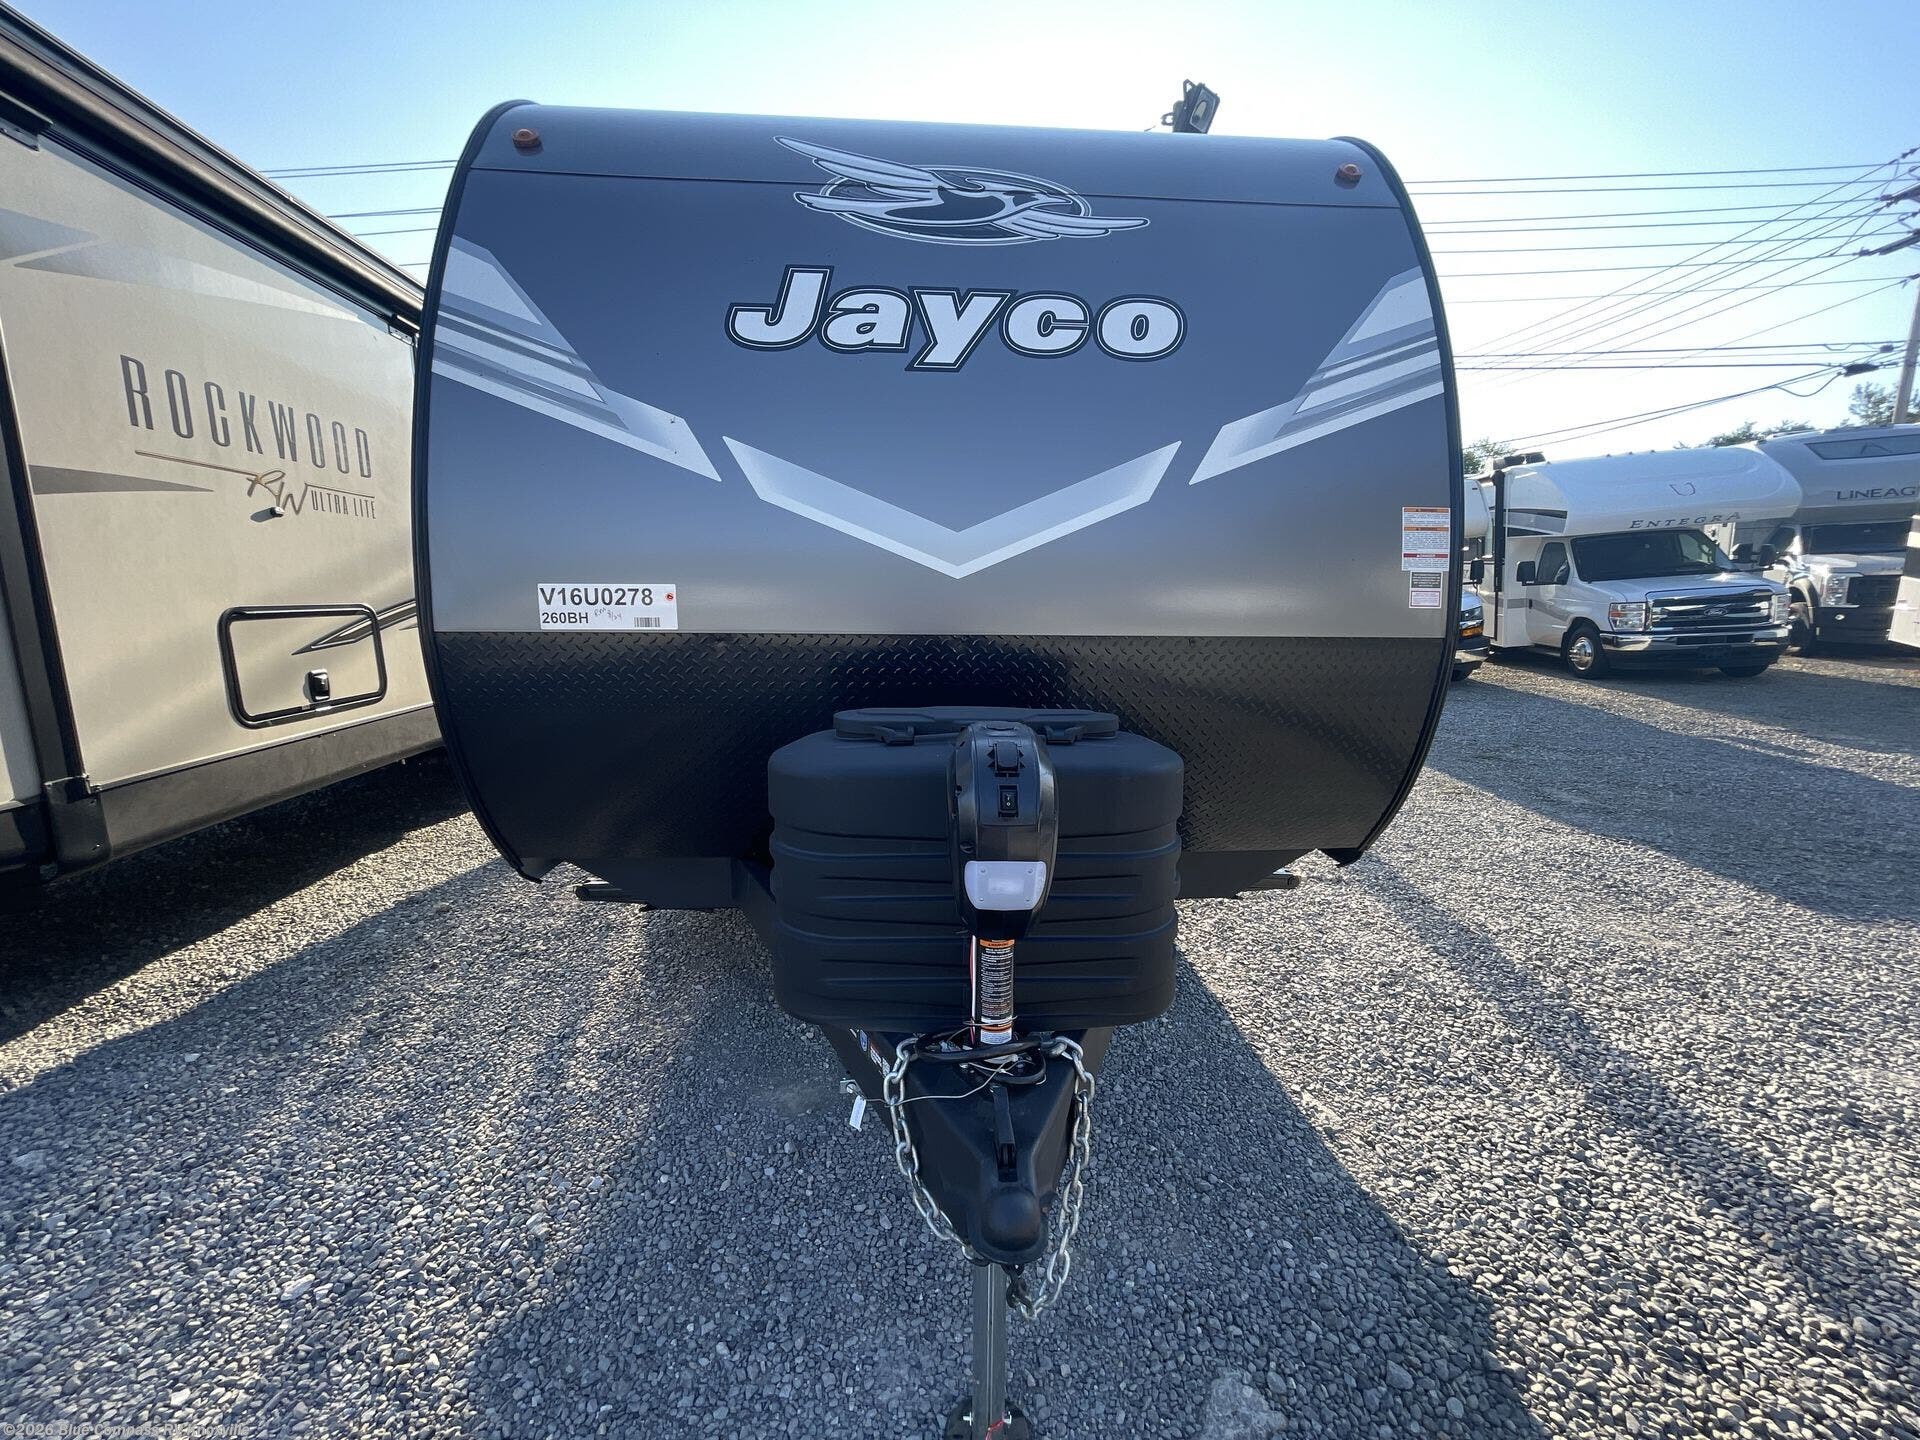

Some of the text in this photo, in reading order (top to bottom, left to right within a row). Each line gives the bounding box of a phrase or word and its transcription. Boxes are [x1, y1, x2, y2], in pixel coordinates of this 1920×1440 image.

[727, 266, 1186, 370] Jayco
[119, 354, 373, 479] ROCKWOOD
[310, 489, 377, 519] ULTRA LITE
[1629, 512, 1741, 529] ENTEGRA
[539, 587, 653, 606] V16U0278
[542, 612, 589, 624] 260BH
